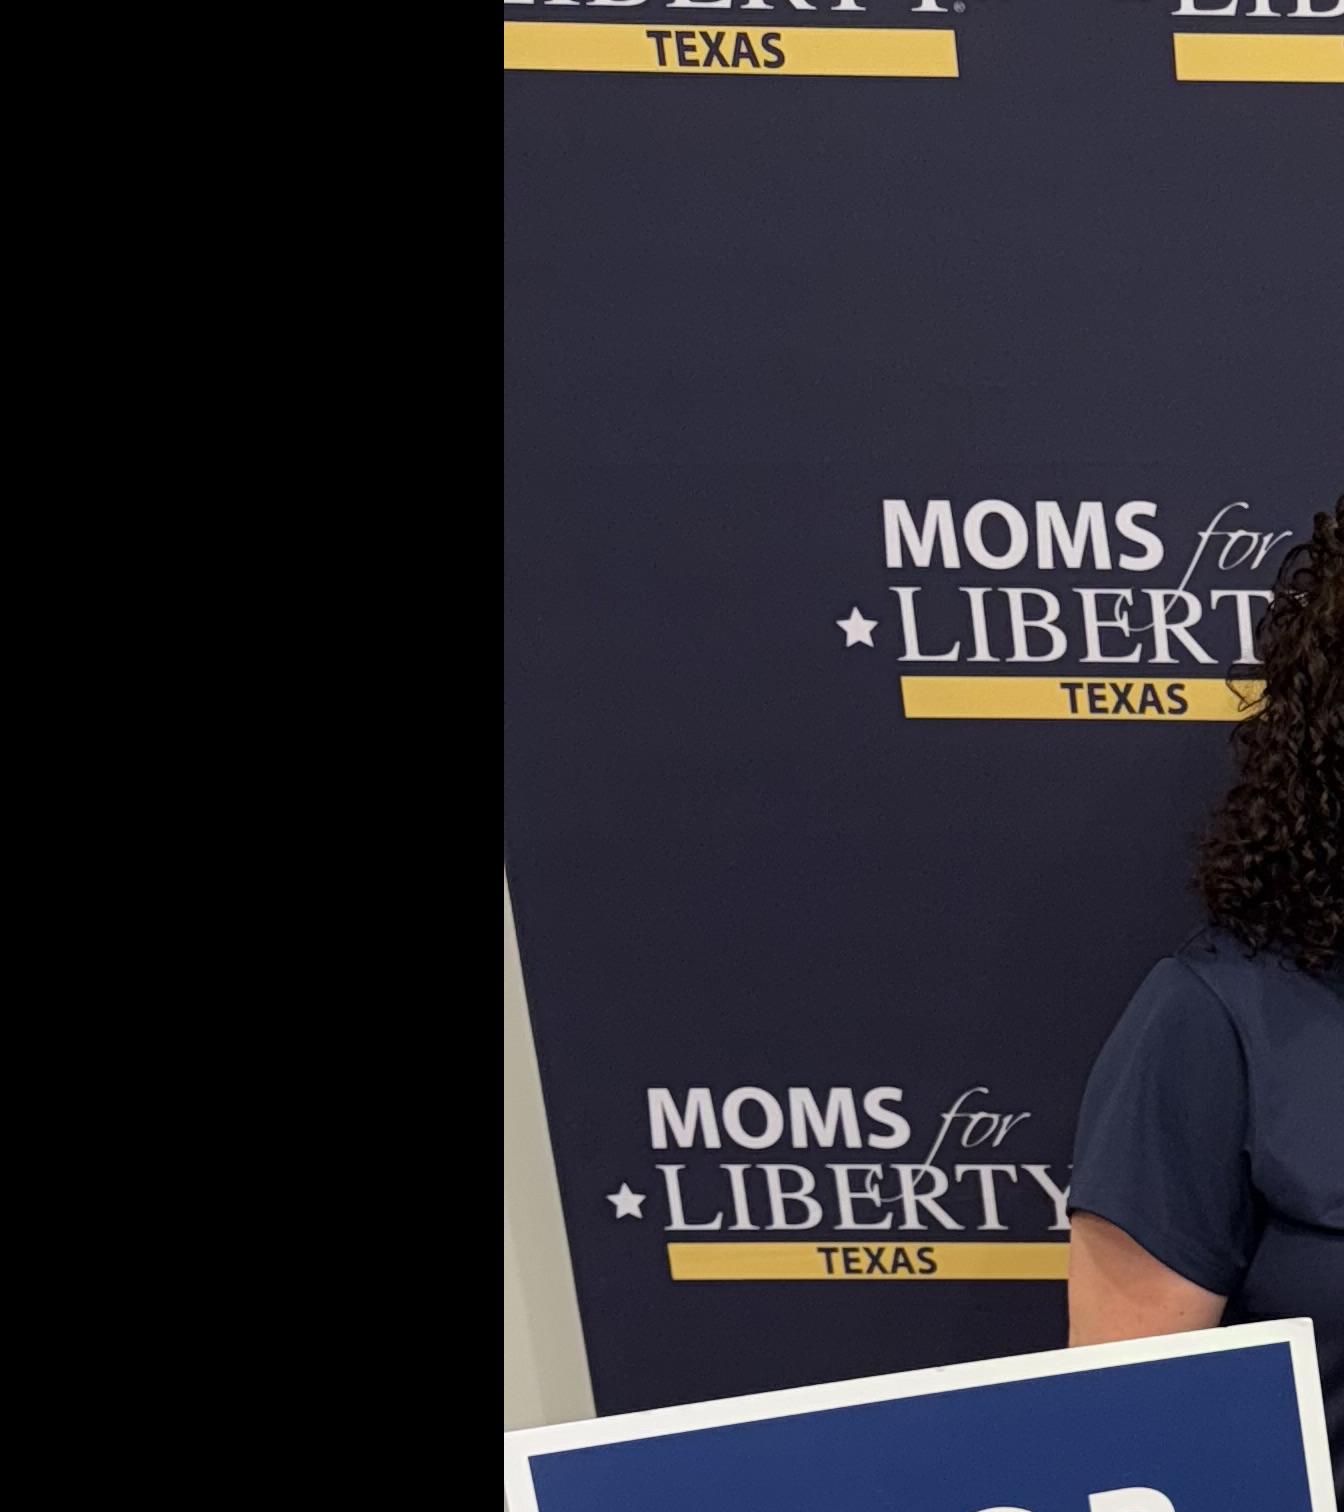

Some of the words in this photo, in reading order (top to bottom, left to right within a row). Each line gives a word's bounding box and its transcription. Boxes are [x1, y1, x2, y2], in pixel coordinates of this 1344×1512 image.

[646, 29, 786, 69] TEXAS
[883, 499, 1165, 571] MOMS
[889, 586, 1275, 664] LIBERT
[1060, 683, 1188, 715] TEXAS
[648, 1087, 911, 1149] MOMS
[656, 1164, 1072, 1231] LIBERTY
[817, 1247, 937, 1274] TEXAS
